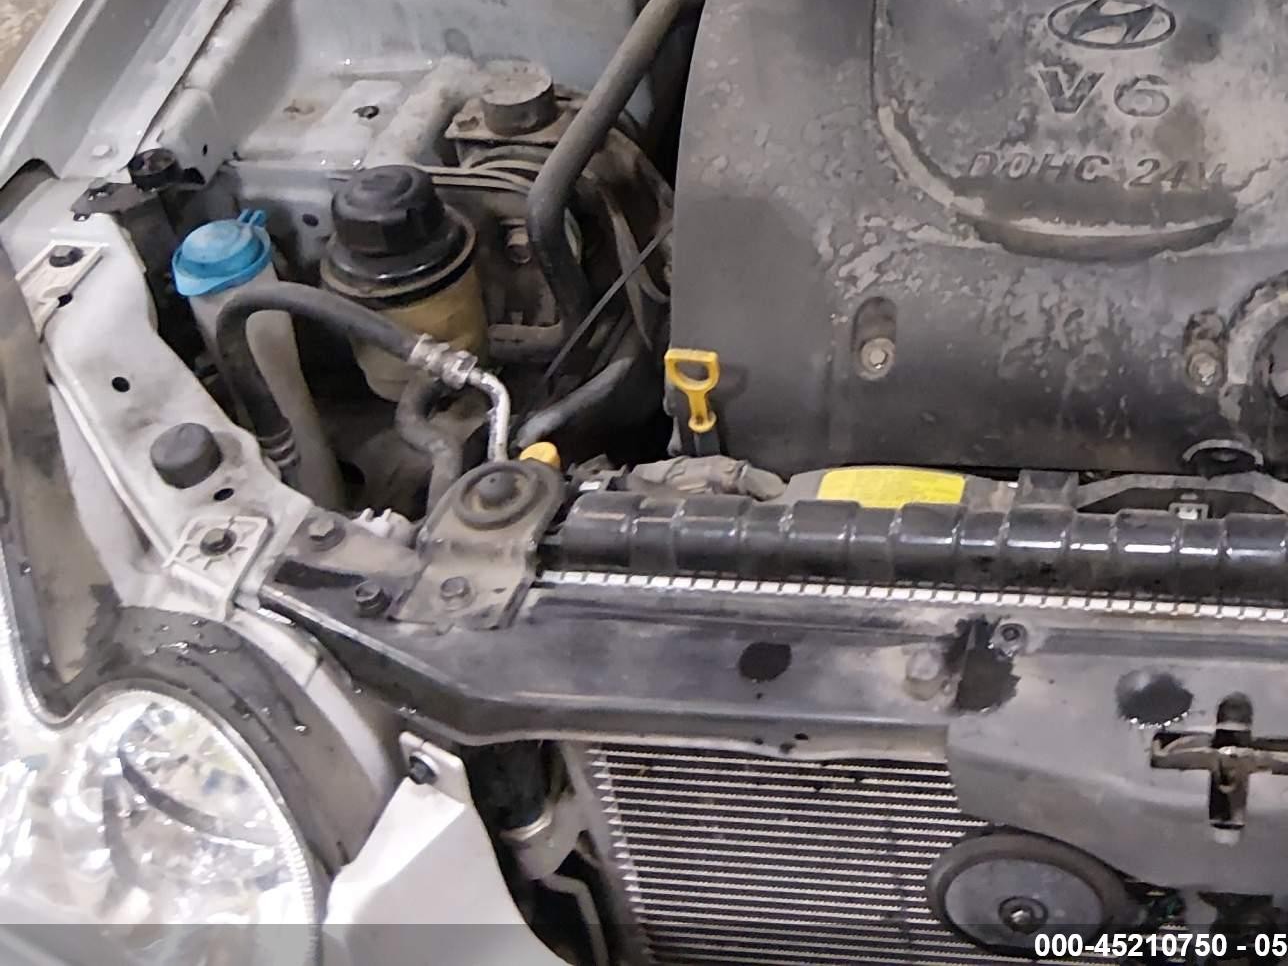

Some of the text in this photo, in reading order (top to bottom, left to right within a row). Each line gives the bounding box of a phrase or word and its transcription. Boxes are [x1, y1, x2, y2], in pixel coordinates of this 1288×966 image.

[1035, 65, 1170, 118] V6
[968, 149, 1229, 189] DOHC 24V
